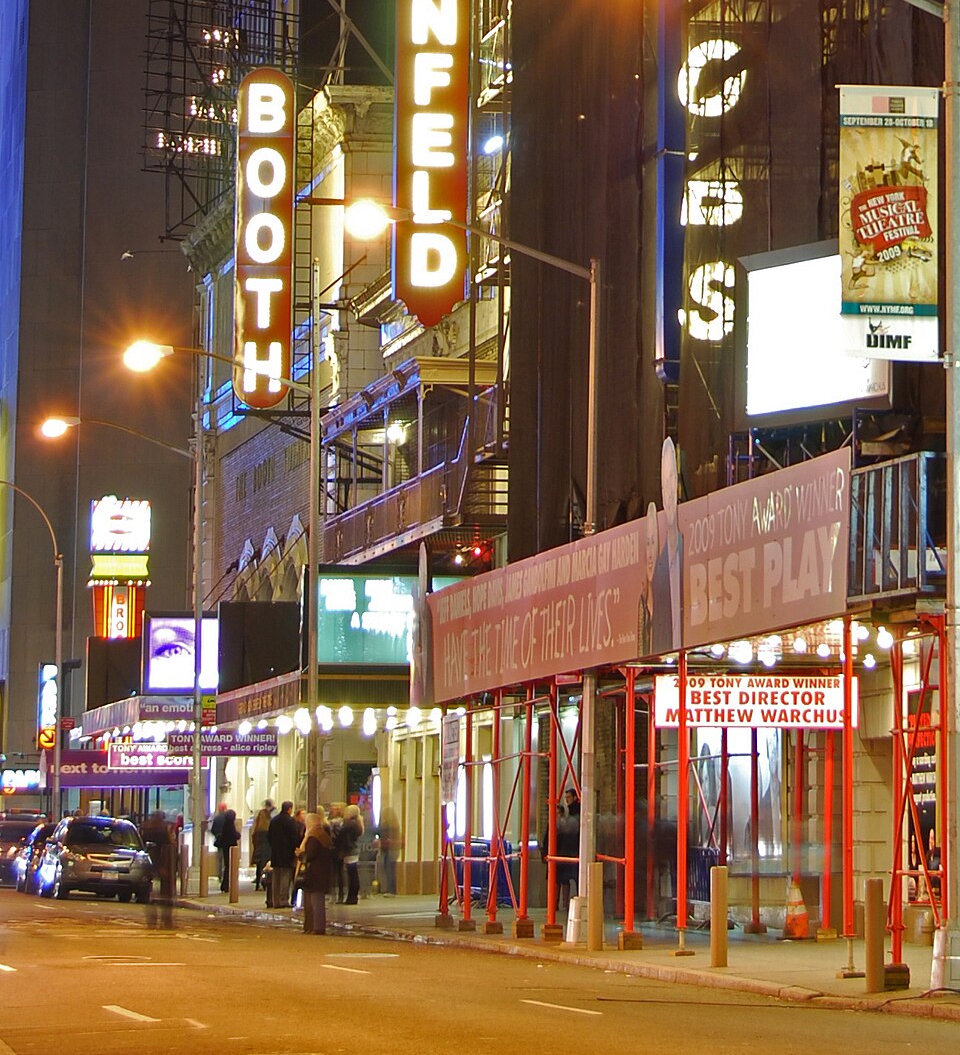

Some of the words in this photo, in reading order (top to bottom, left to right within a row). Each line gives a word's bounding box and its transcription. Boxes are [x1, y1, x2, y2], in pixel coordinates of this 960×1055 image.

[843, 117, 883, 126] SEPTEMBER
[867, 195, 885, 208] NEW
[885, 191, 905, 202] YORK
[859, 200, 917, 225] MUSICAL
[856, 211, 925, 239] THEATRE
[883, 225, 920, 241] FESTIVAL
[244, 82, 287, 393] BOOTH
[877, 245, 901, 262] 2009
[859, 304, 915, 315] WWW.NYMF.ORG
[866, 333, 912, 349] DIMF
[688, 515, 715, 557] 2009
[717, 498, 748, 546] TONY
[795, 467, 845, 524] WINNER
[557, 557, 571, 587] AND
[690, 547, 756, 626] BEST
[763, 521, 842, 609] PLAY
[444, 630, 469, 688] HAVE
[471, 620, 492, 676] THE
[494, 616, 519, 674] TIME
[520, 607, 538, 669] OF
[540, 594, 576, 662] THEIR
[673, 678, 705, 688] 209
[710, 678, 741, 688] TONY
[747, 678, 790, 688] AWARD
[793, 678, 840, 689] WINNER
[690, 691, 731, 705] BEST
[739, 691, 825, 705] DIRECTOR
[665, 708, 754, 723] MATTHEW
[235, 734, 276, 743] WINNER!
[252, 744, 277, 753] ripley
[120, 753, 153, 766] best
[91, 763, 109, 774] to
